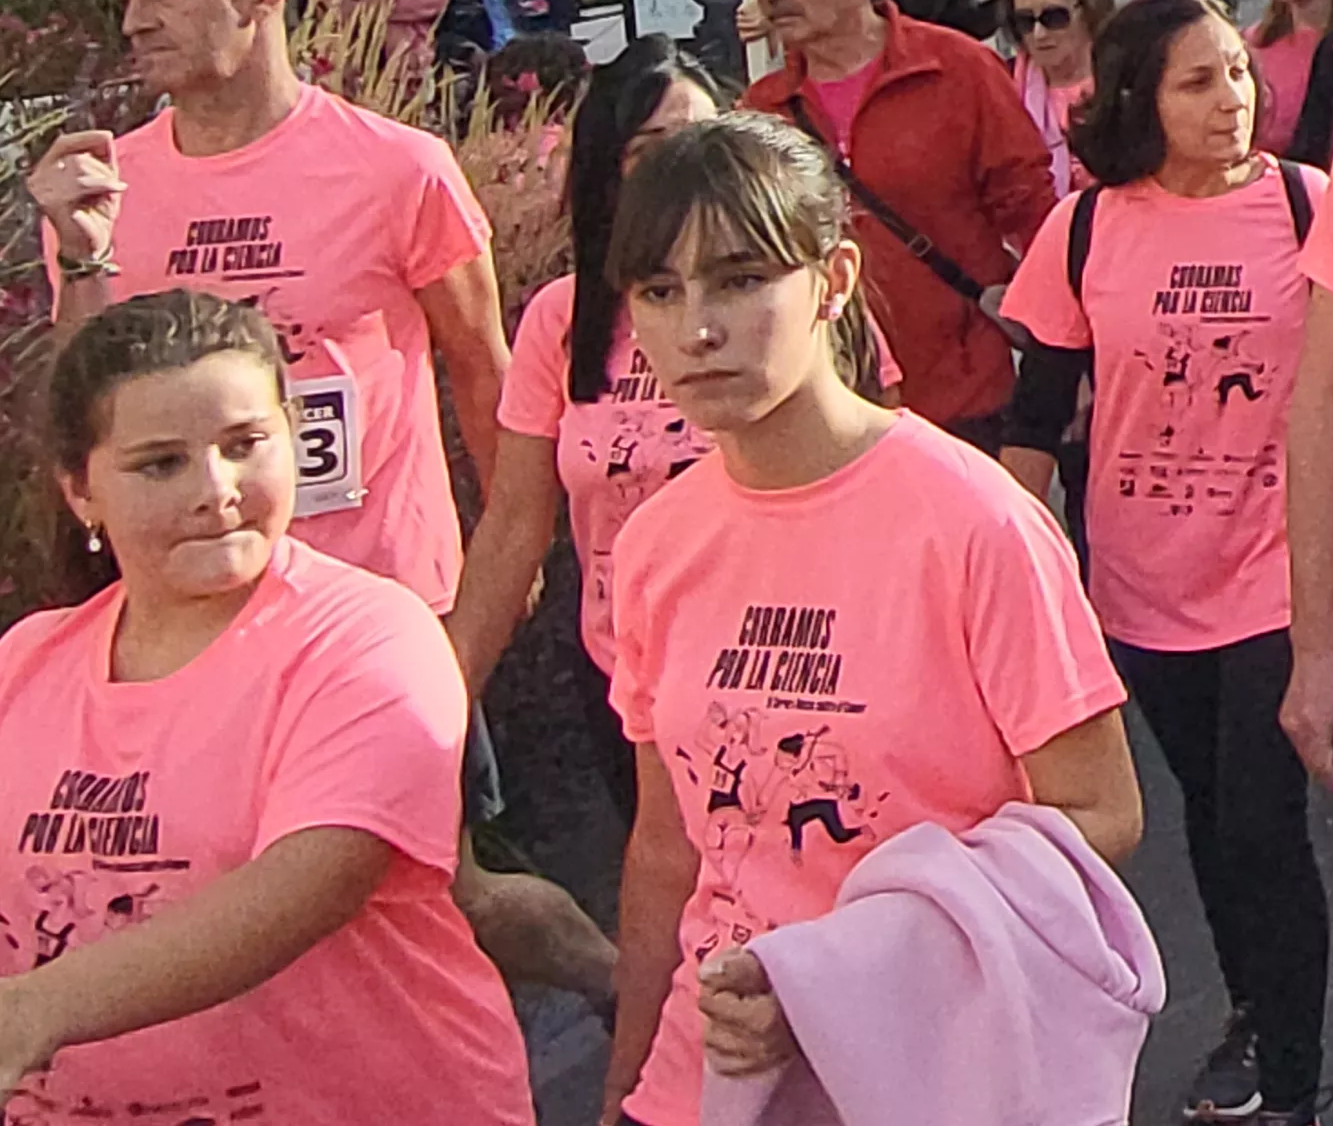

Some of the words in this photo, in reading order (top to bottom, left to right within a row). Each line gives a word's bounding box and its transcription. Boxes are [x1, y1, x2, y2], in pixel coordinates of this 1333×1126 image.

[739, 605, 836, 649] CURRAMOS
[706, 648, 750, 689] POR
[745, 649, 772, 690] LA
[770, 650, 842, 695] CIENCIA
